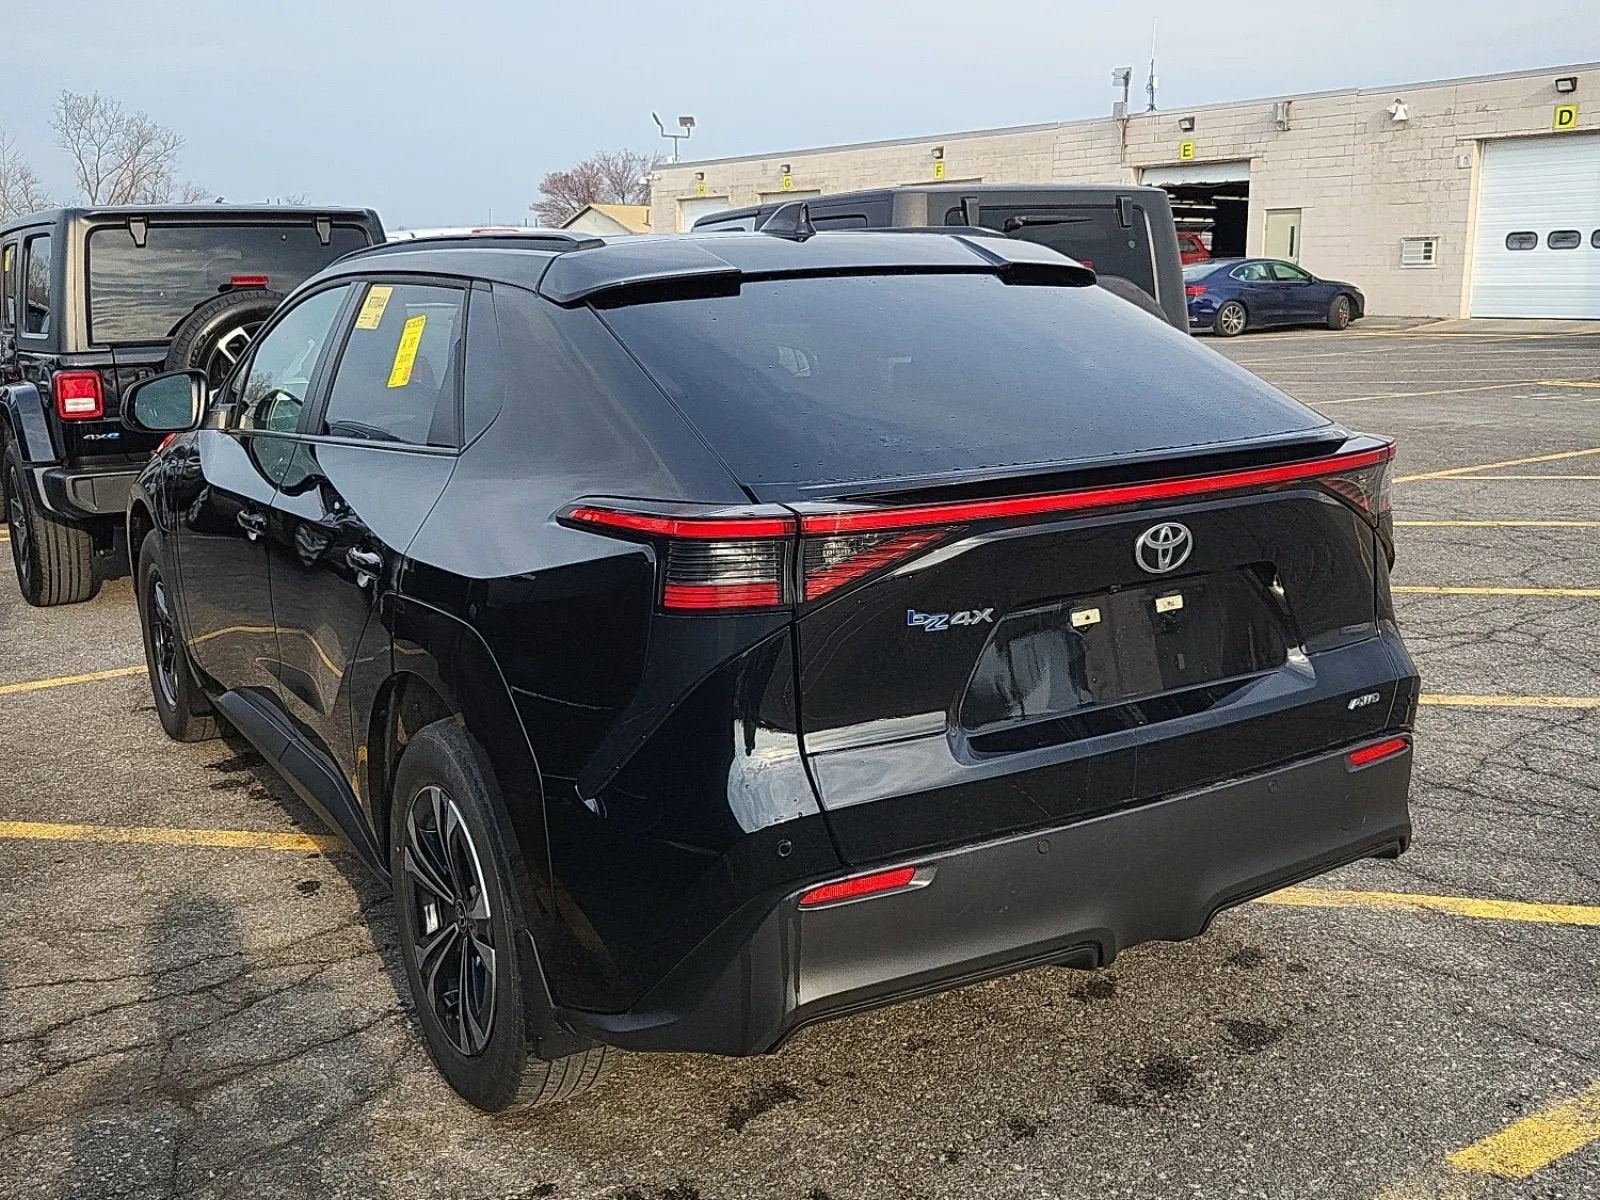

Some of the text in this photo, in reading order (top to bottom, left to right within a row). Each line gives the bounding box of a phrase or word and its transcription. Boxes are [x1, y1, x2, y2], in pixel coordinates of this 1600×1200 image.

[1558, 109, 1573, 126] D
[1182, 143, 1192, 158] E
[935, 165, 943, 177] F
[784, 179, 791, 189] G
